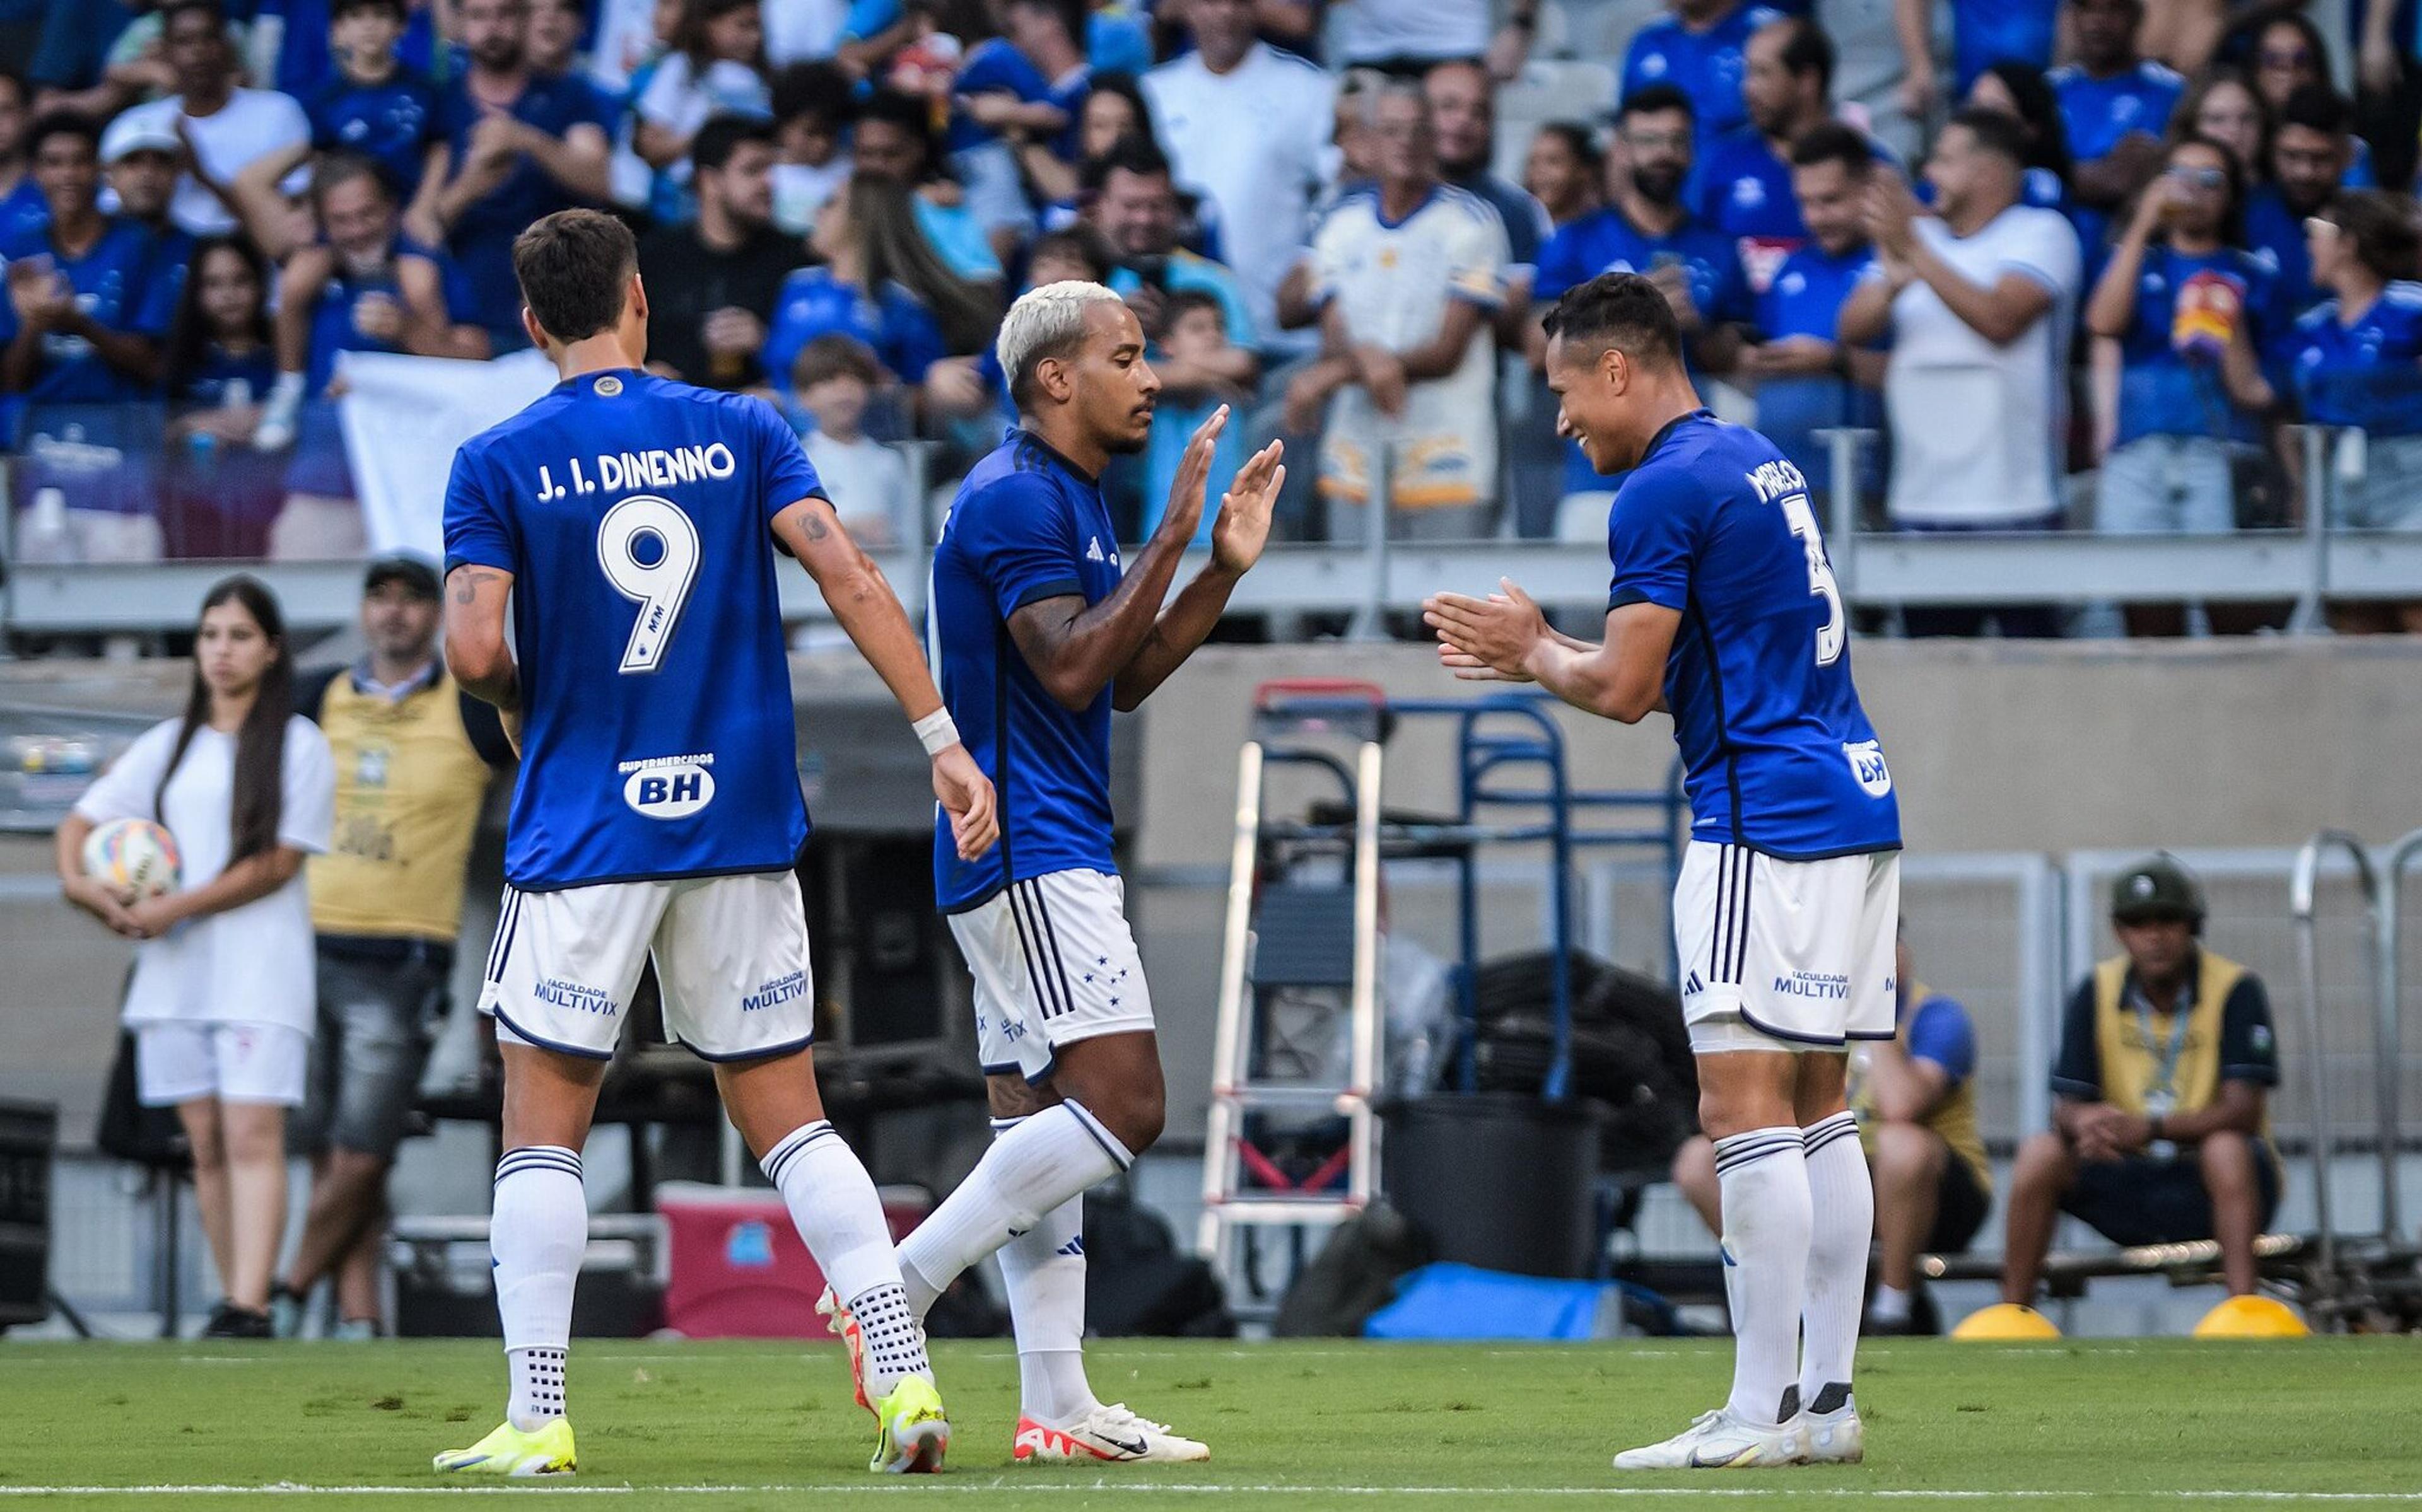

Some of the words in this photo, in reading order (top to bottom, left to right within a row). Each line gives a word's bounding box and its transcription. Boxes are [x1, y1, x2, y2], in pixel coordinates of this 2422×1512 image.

[537, 465, 566, 503] J.
[570, 458, 595, 496] I.
[598, 443, 735, 492] DINENNO
[1745, 459, 1808, 505] MARLO
[597, 494, 700, 675] 9
[1780, 494, 1846, 666] 3
[618, 753, 715, 774] SUPERMERCADOS
[1856, 756, 1887, 783] BH
[638, 772, 701, 806] BH
[547, 979, 607, 998] FACULDADE
[1774, 977, 1852, 999] MULTIVI
[1793, 971, 1849, 984] FACULDADE
[534, 982, 619, 1016] MULTIVIX
[742, 979, 807, 1011] MULTIVI
